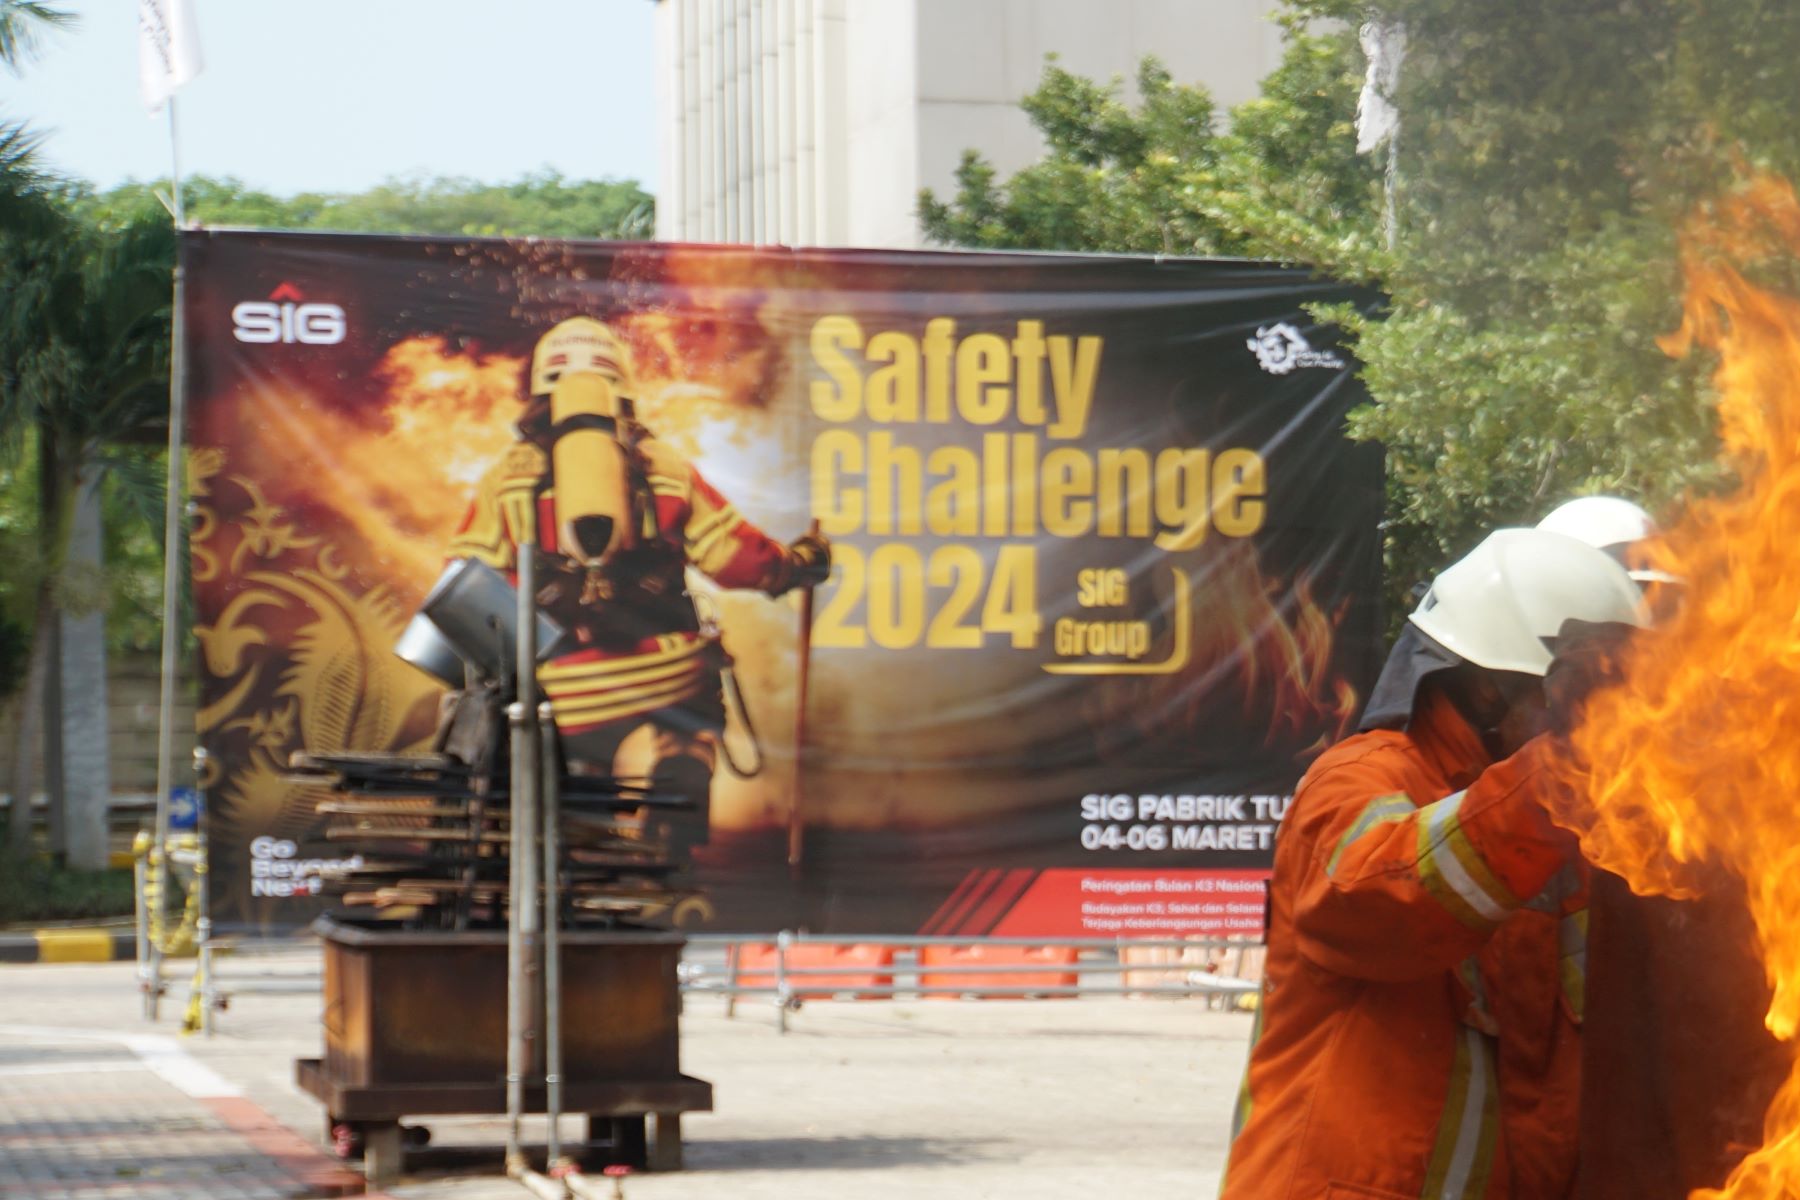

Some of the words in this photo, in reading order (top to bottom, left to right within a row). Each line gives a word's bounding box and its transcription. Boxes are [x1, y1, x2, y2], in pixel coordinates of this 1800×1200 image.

[231, 301, 346, 344] SIG
[810, 315, 1103, 438] Safety
[810, 429, 1266, 551] Challenge
[811, 543, 1040, 649] 2024
[1077, 568, 1128, 607] SIG
[1054, 618, 1150, 658] Group
[1081, 794, 1133, 820] SIG
[1138, 794, 1246, 820] PABRIK
[250, 836, 298, 858] Go
[1081, 824, 1167, 849] 04-06
[1172, 825, 1273, 849] MARET
[251, 876, 322, 896] Next
[1081, 878, 1152, 895] Peringatan
